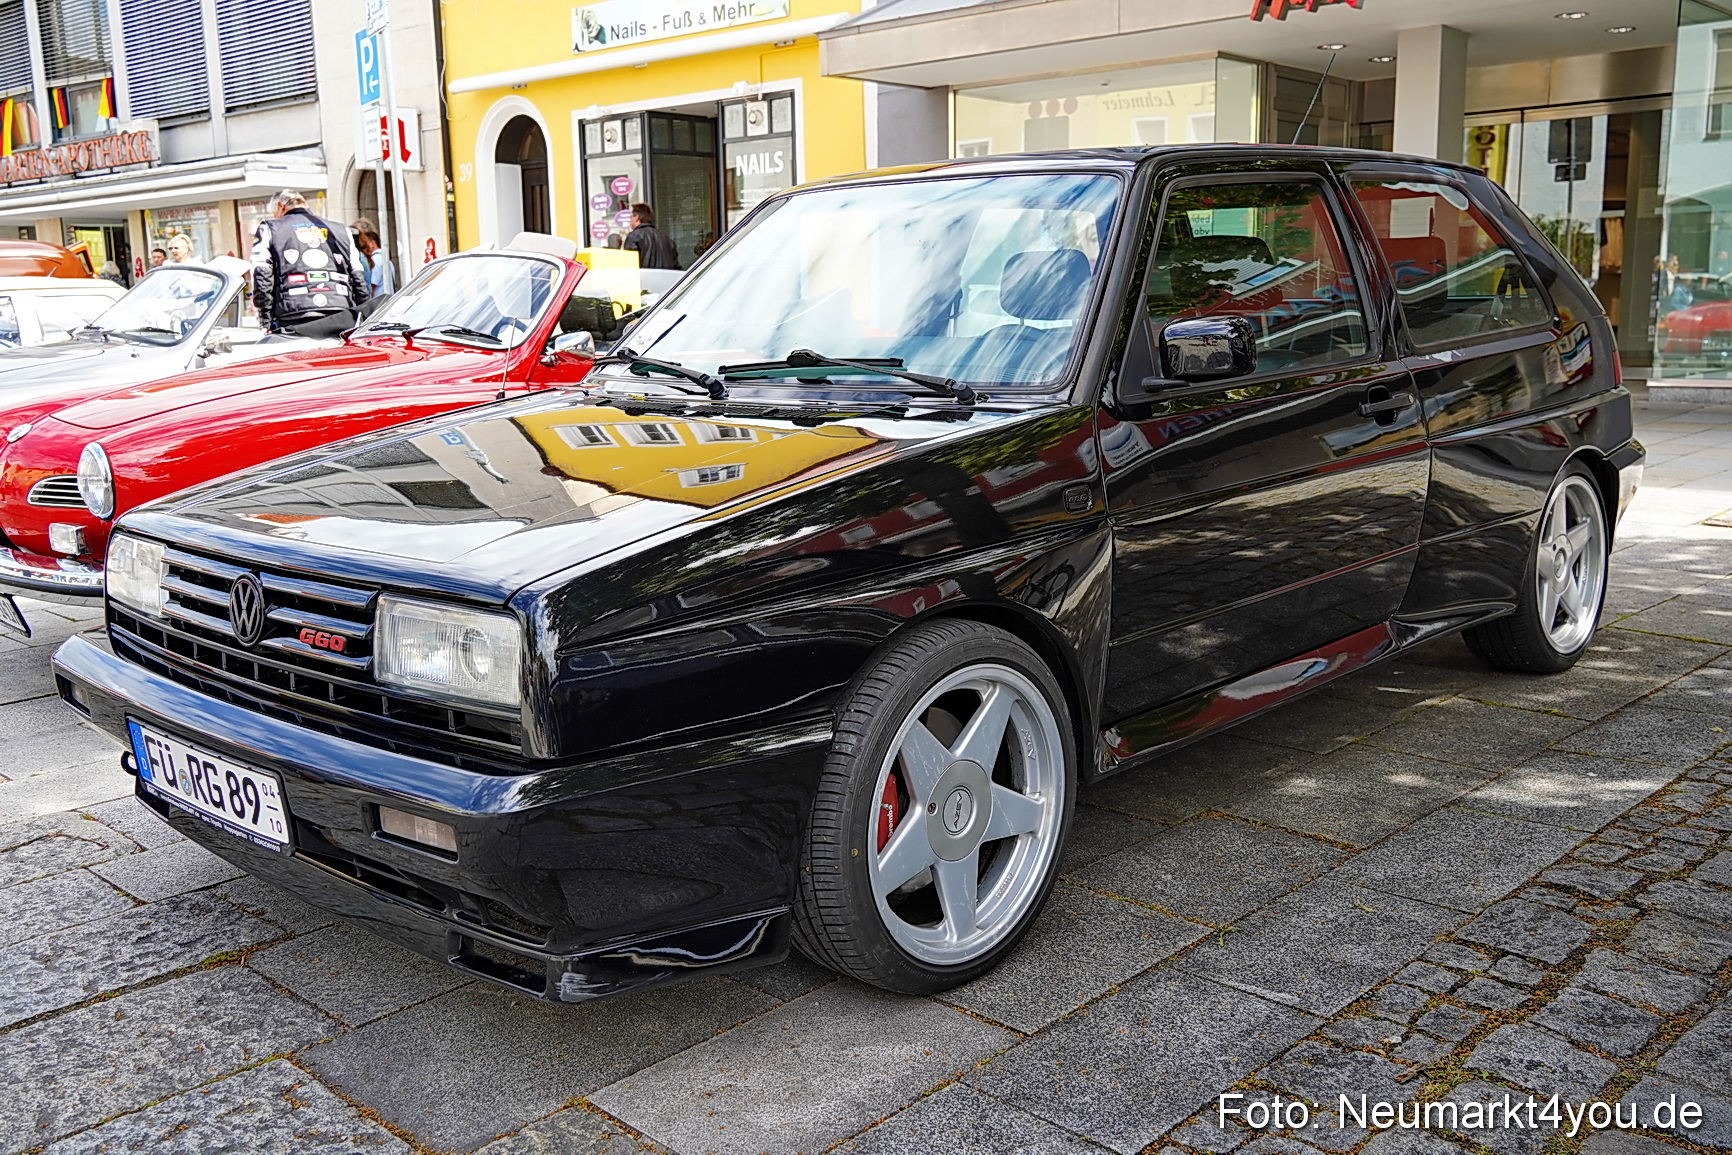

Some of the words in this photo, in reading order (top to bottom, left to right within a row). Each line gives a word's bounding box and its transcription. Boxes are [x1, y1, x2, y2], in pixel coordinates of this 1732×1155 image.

[611, 21, 647, 41] Nails
[662, 11, 692, 32] Fuß
[698, 13, 707, 25] &
[713, 1, 755, 22] Mehr
[360, 38, 373, 95] P
[459, 162, 472, 182] 39
[736, 150, 784, 177] NAILS
[299, 628, 345, 652] G60
[144, 734, 179, 791] FÜ
[262, 783, 275, 799] 04
[269, 817, 282, 834] 10
